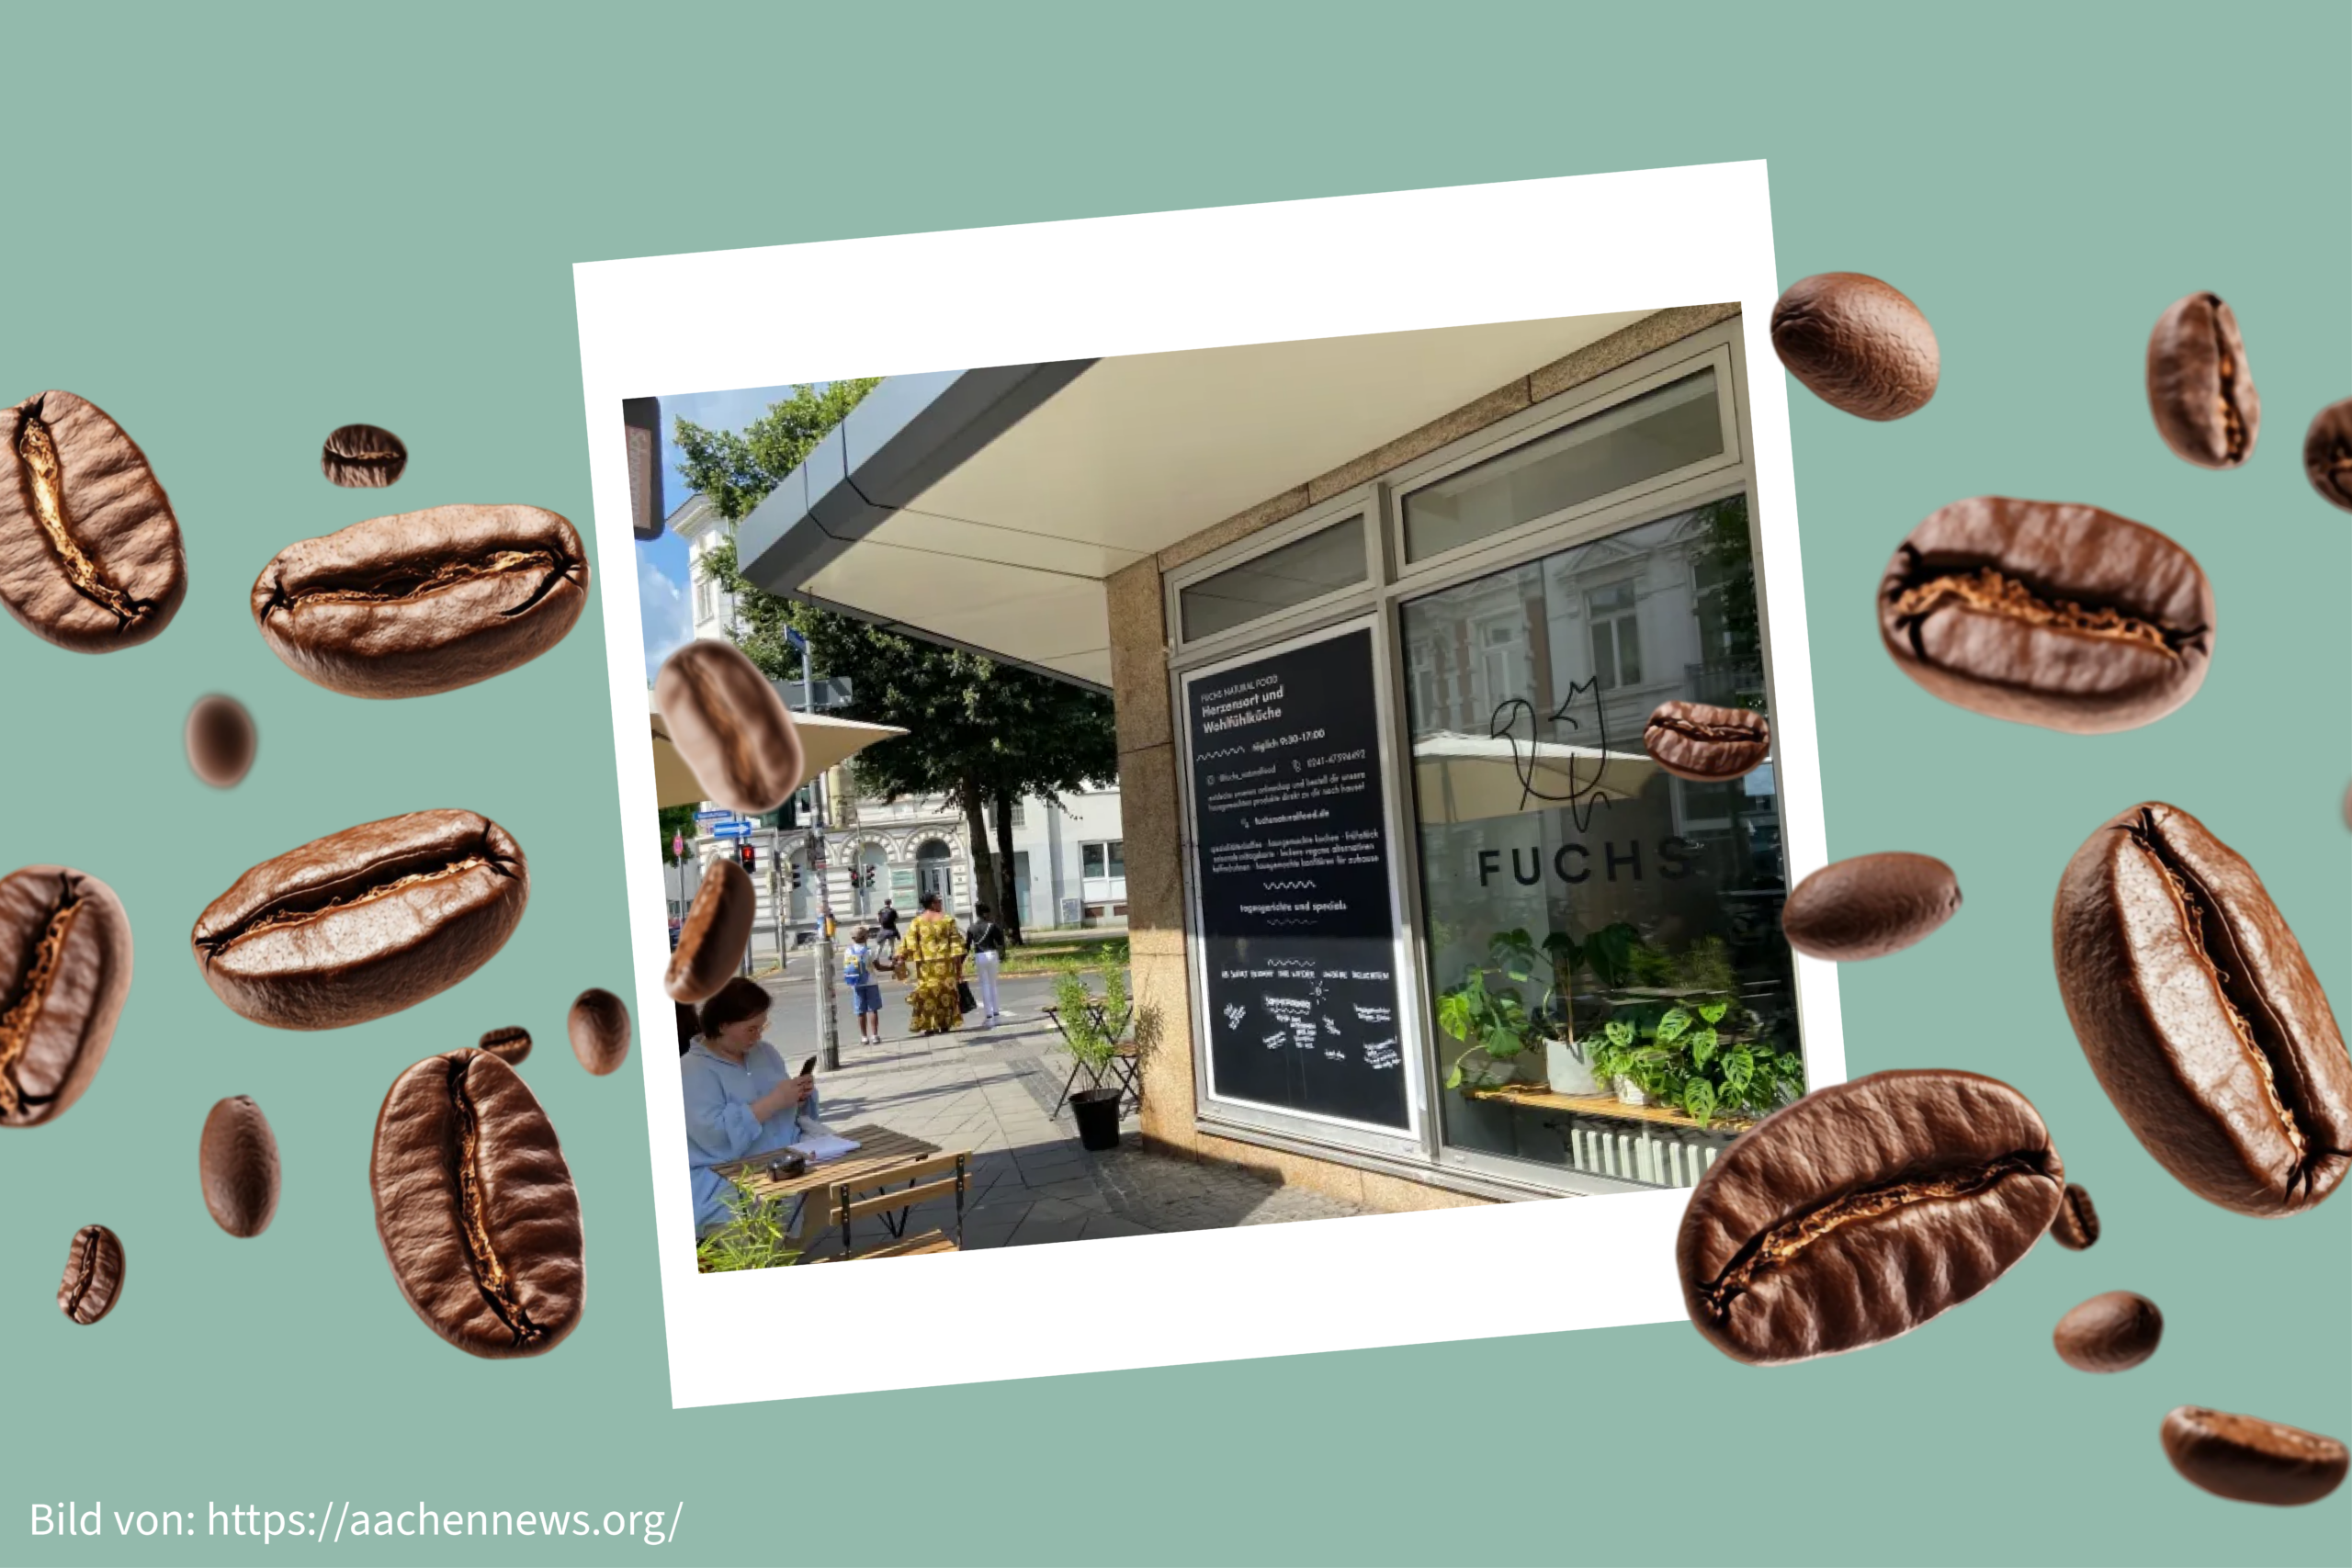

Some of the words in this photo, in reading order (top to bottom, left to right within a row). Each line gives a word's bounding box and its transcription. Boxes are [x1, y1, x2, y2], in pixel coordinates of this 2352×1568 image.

[1201, 690, 1224, 703] FUCHS
[1224, 682, 1255, 697] NATURAL
[1255, 674, 1278, 687] FOOD
[1202, 694, 1260, 717] Herzensort
[1261, 684, 1284, 703] und
[1204, 706, 1282, 733] Wohlfühlküche
[1477, 835, 1695, 887] FUCHS
